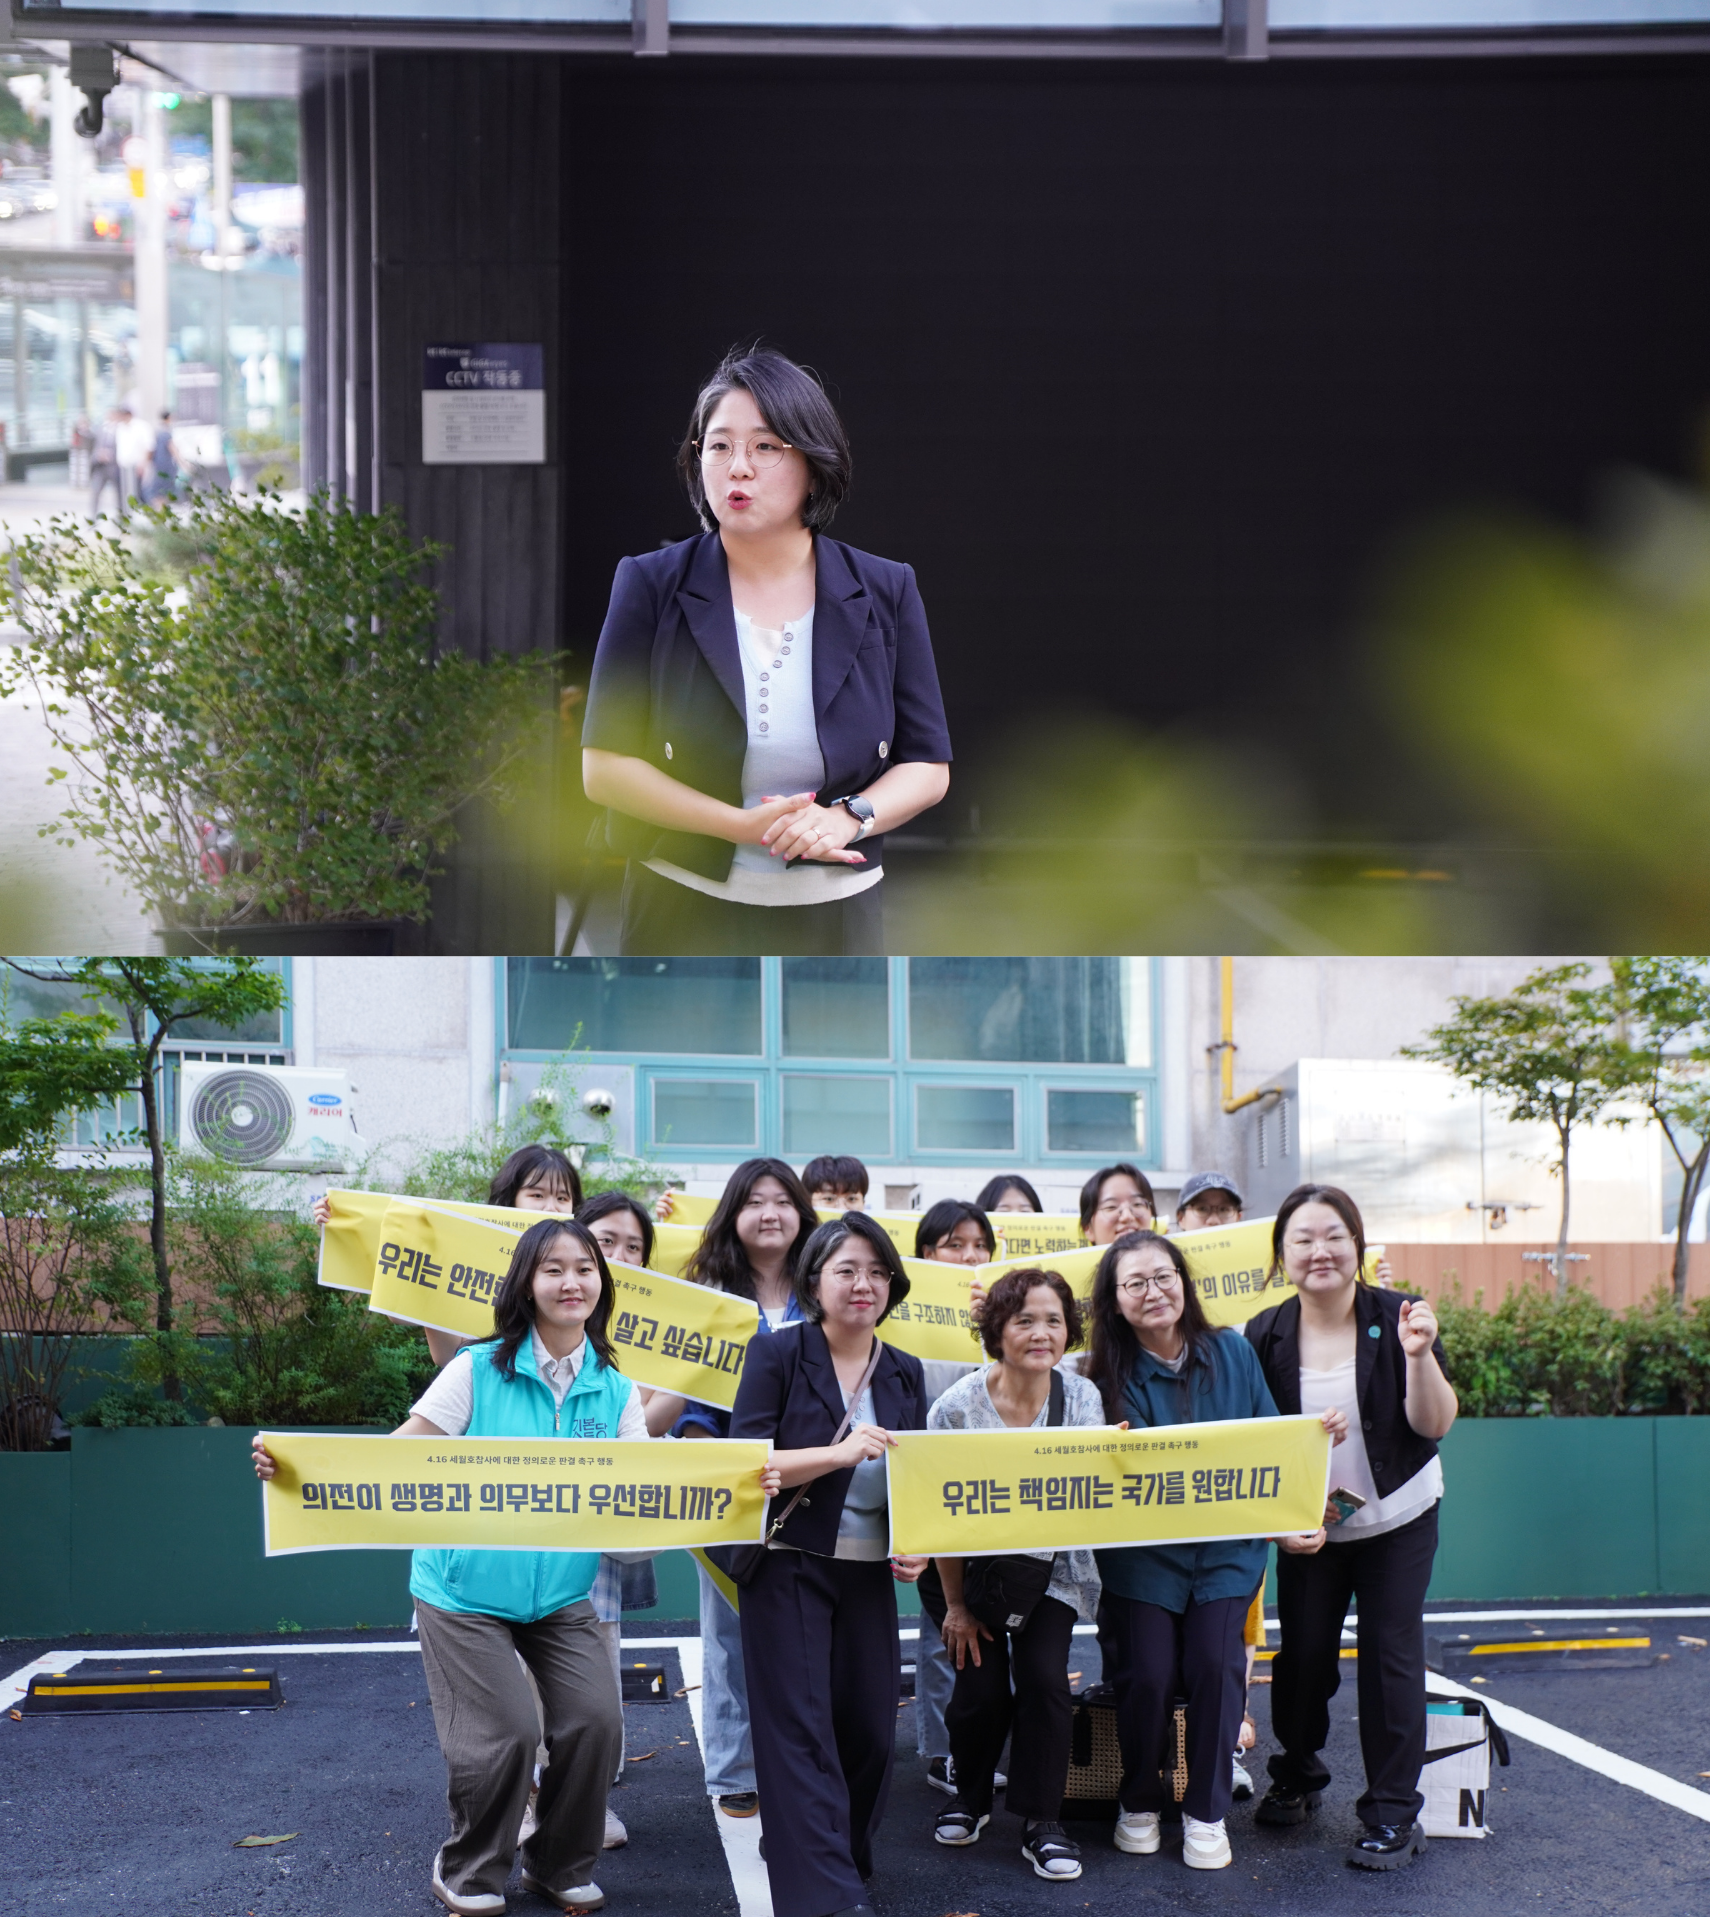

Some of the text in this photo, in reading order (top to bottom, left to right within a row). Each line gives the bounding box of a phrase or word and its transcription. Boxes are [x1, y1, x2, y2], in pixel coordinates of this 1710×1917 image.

[445, 370, 522, 388] CCTV 작동중
[311, 1094, 339, 1104] Carrier
[307, 1106, 343, 1117] 캐리어
[512, 1221, 526, 1230] 대한
[1006, 1237, 1031, 1254] 다면
[622, 1281, 637, 1292] 촉구
[638, 1286, 653, 1297] 행동
[1222, 1268, 1265, 1296] 이유를
[378, 1242, 443, 1290] 우리는
[613, 1311, 659, 1351] 살고
[660, 1325, 746, 1376] 싶습니다
[913, 1302, 957, 1327] 구조하지
[573, 1417, 595, 1431] 기본
[1034, 1440, 1199, 1455] 4.16 세월호참사에 대한 정의로운 판결 촉구 행동
[426, 1455, 614, 1466] 4.16 세월호참사에 대한 정의로운 판결 촉구 행동
[943, 1466, 1281, 1516] 우리는 책임지는 국가를 원합니다
[301, 1482, 733, 1521] 의전이 생명과 의무보다 우선합니까?
